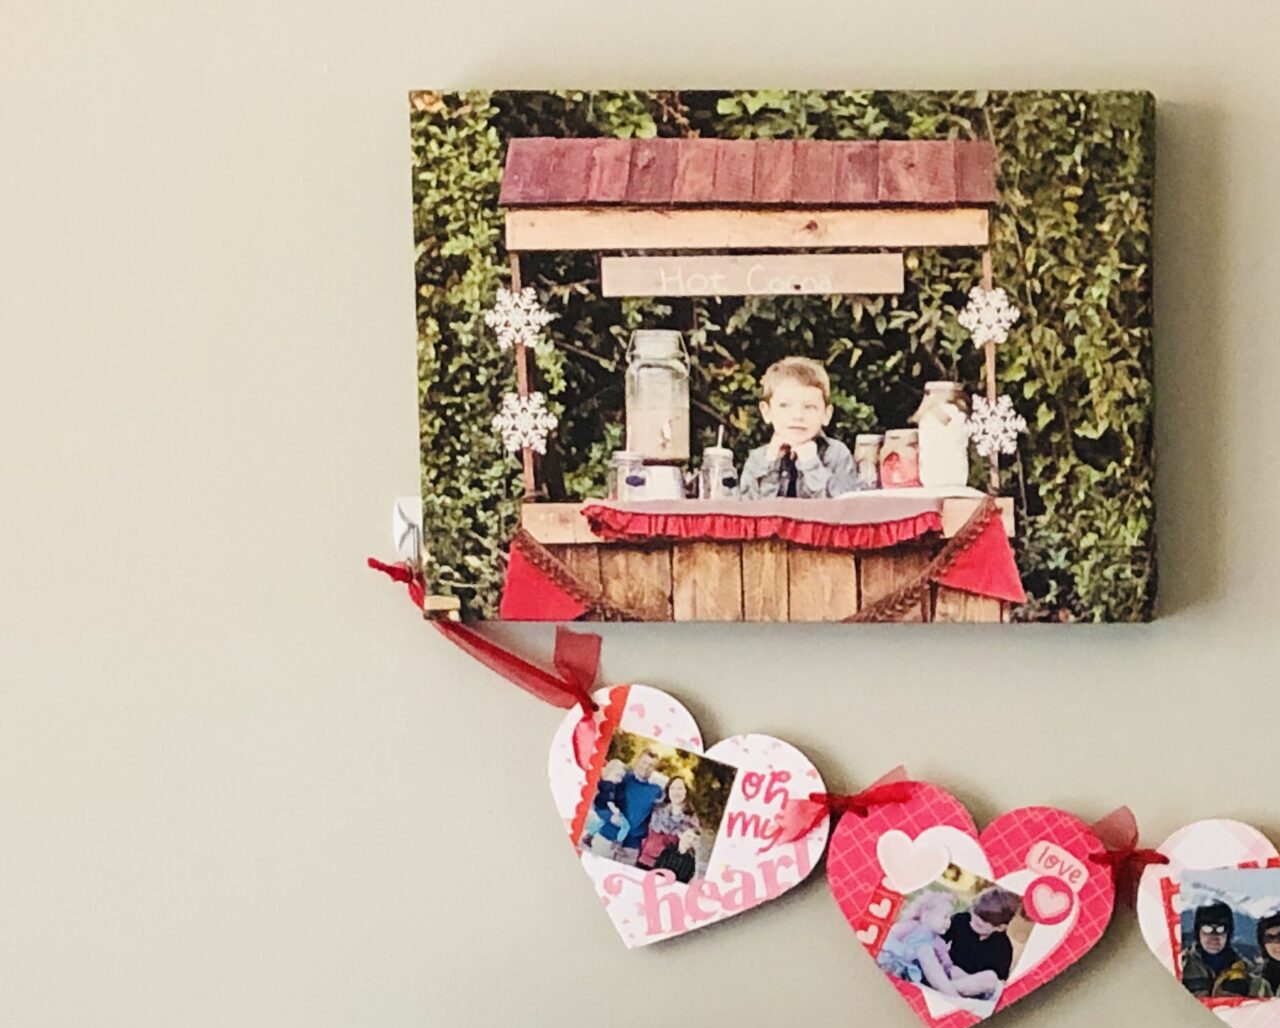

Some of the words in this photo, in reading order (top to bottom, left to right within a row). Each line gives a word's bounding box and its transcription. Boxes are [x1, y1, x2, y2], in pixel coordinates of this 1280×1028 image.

[658, 266, 728, 294] Hot
[746, 264, 832, 294] Cocoa
[741, 769, 791, 810] oh
[726, 810, 786, 856] my
[1035, 847, 1083, 886] love
